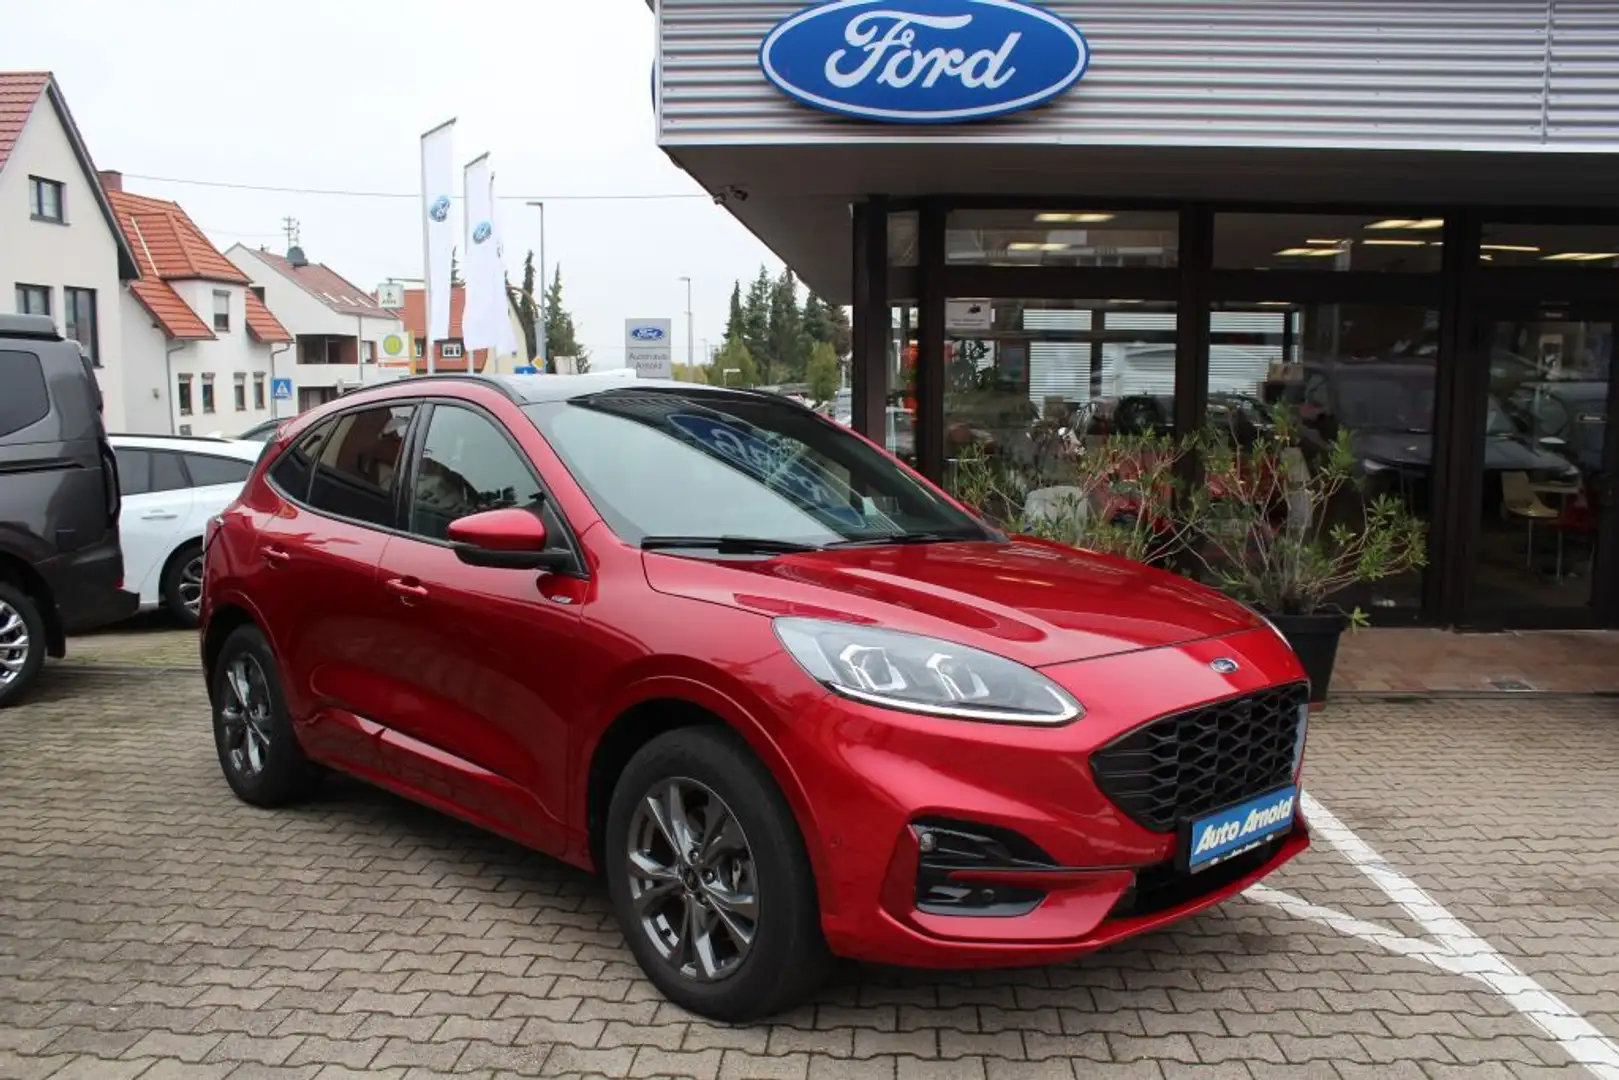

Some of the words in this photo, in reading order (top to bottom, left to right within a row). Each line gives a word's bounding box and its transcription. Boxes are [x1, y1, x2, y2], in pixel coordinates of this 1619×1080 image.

[825, 10, 1021, 89] Ford
[1194, 820, 1240, 856] Auto
[1239, 795, 1294, 837] Arnold
